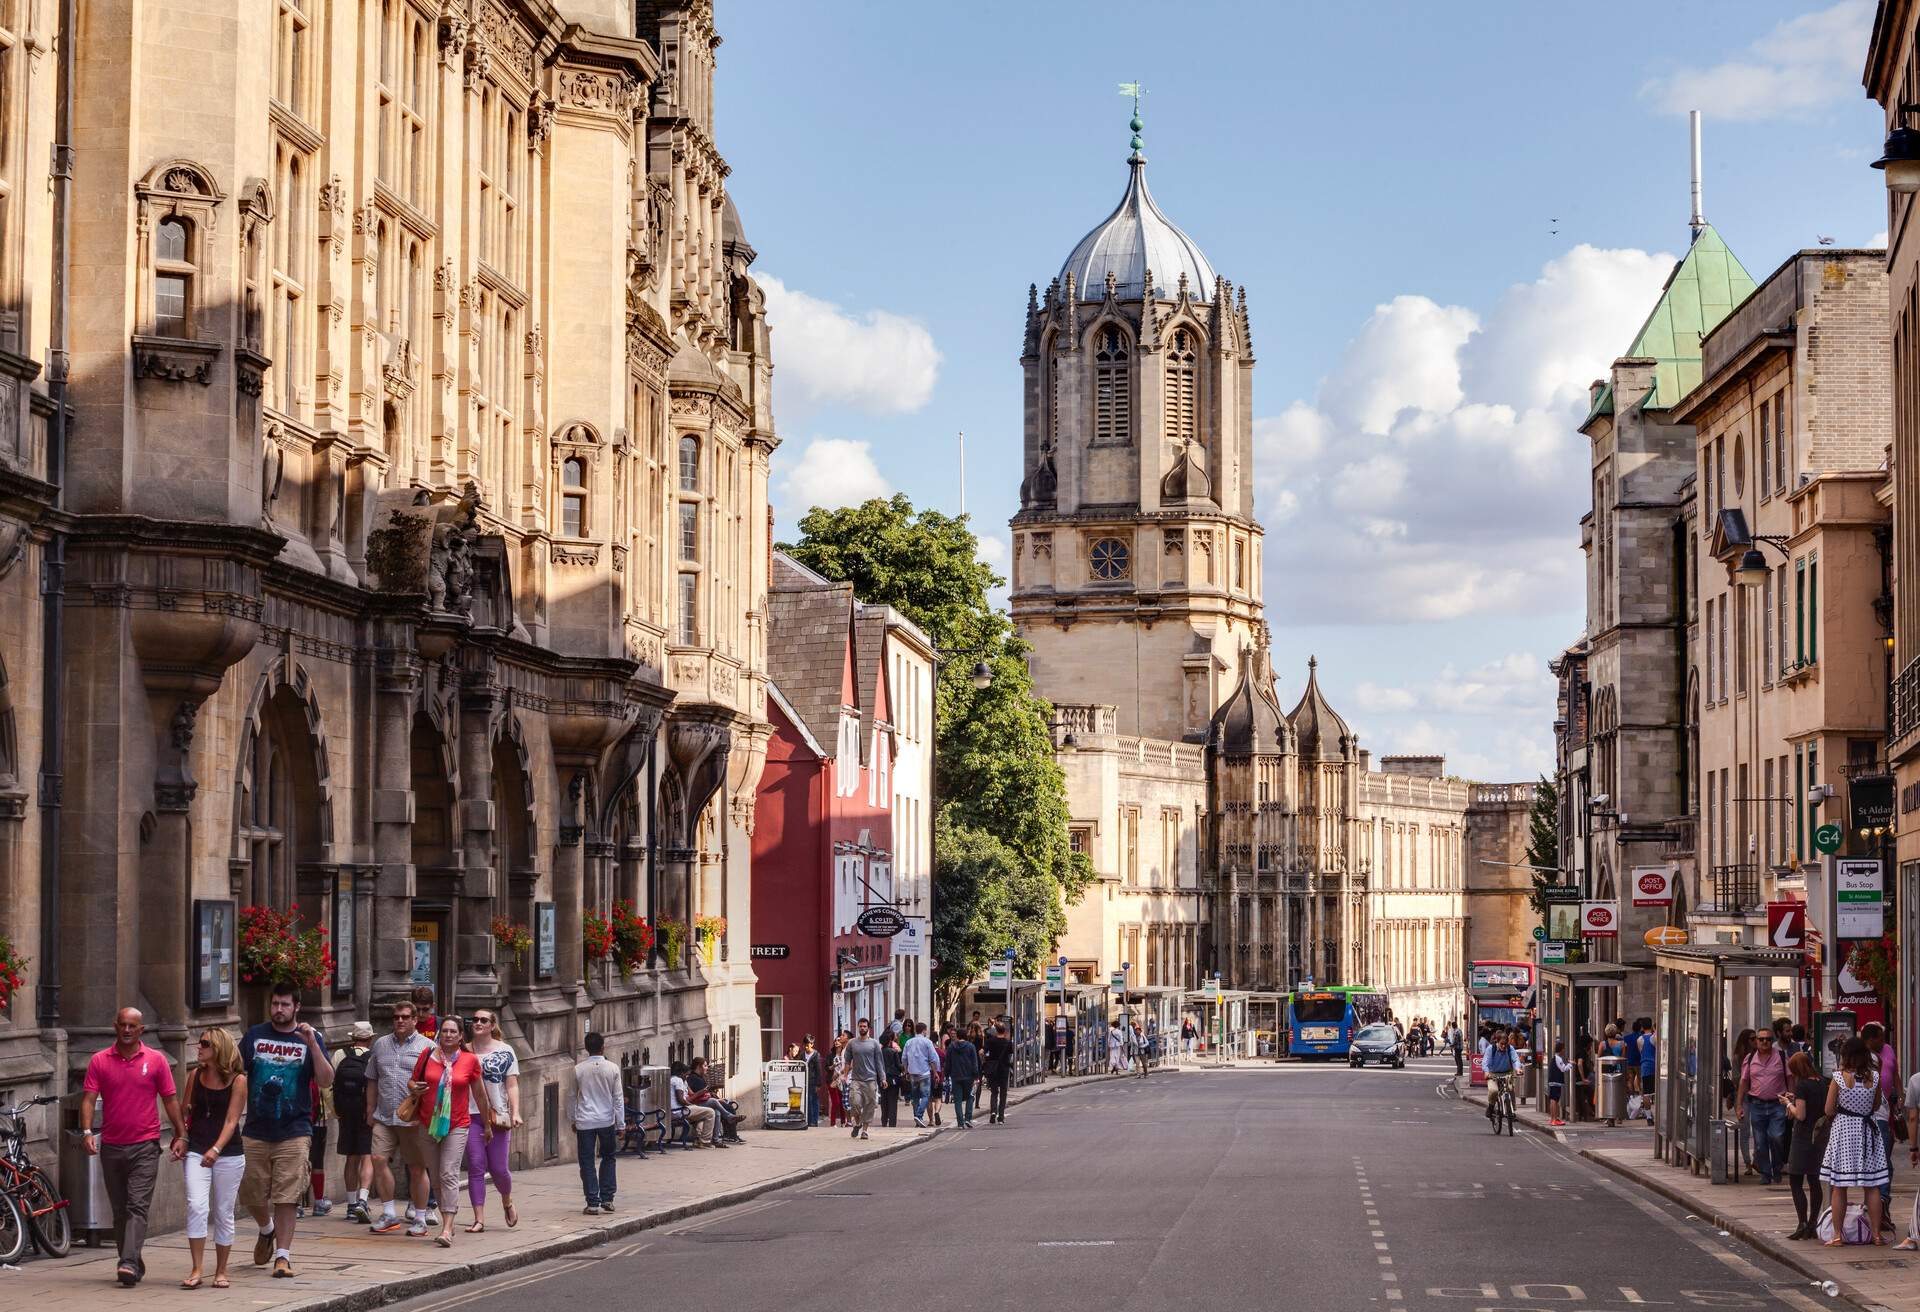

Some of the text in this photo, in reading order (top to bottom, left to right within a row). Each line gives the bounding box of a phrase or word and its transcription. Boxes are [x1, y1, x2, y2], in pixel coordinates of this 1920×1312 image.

[1817, 831, 1840, 845] G4
[1846, 881, 1874, 890] Bus Stop
[859, 908, 881, 924] MATHEWS
[411, 925, 428, 933] Hall
[1838, 996, 1877, 1004] Ladbrokes
[256, 1042, 302, 1056] GNAWS
[1426, 1283, 1768, 1308] STOP
